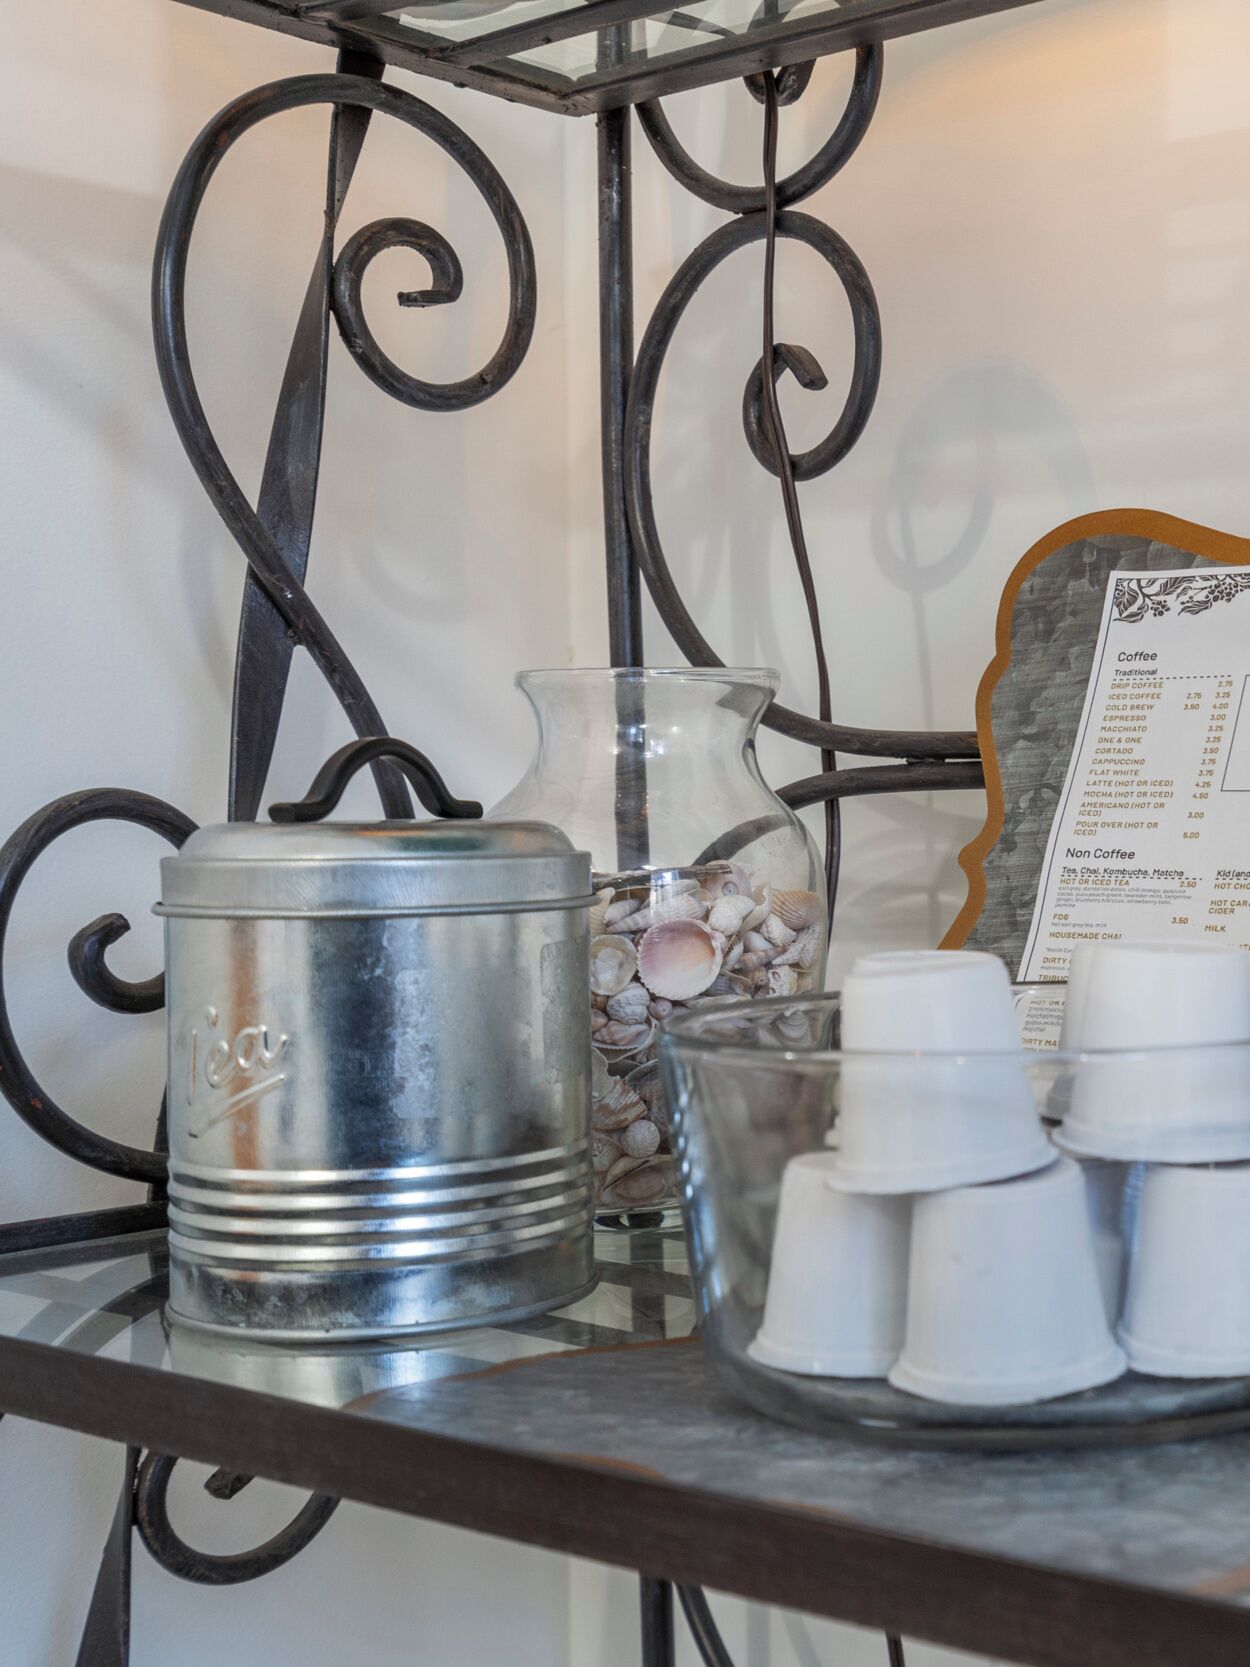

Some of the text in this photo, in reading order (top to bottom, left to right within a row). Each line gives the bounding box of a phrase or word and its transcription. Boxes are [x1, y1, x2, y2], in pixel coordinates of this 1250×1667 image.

[1118, 652, 1158, 662] Coffee
[1114, 668, 1157, 676] Traditional
[1066, 848, 1135, 859] Non Coffee
[1062, 867, 1078, 875] Tea,
[1081, 867, 1100, 875] Chai,
[1103, 868, 1150, 876] Kombucha,
[179, 1006, 289, 1107] Tea
